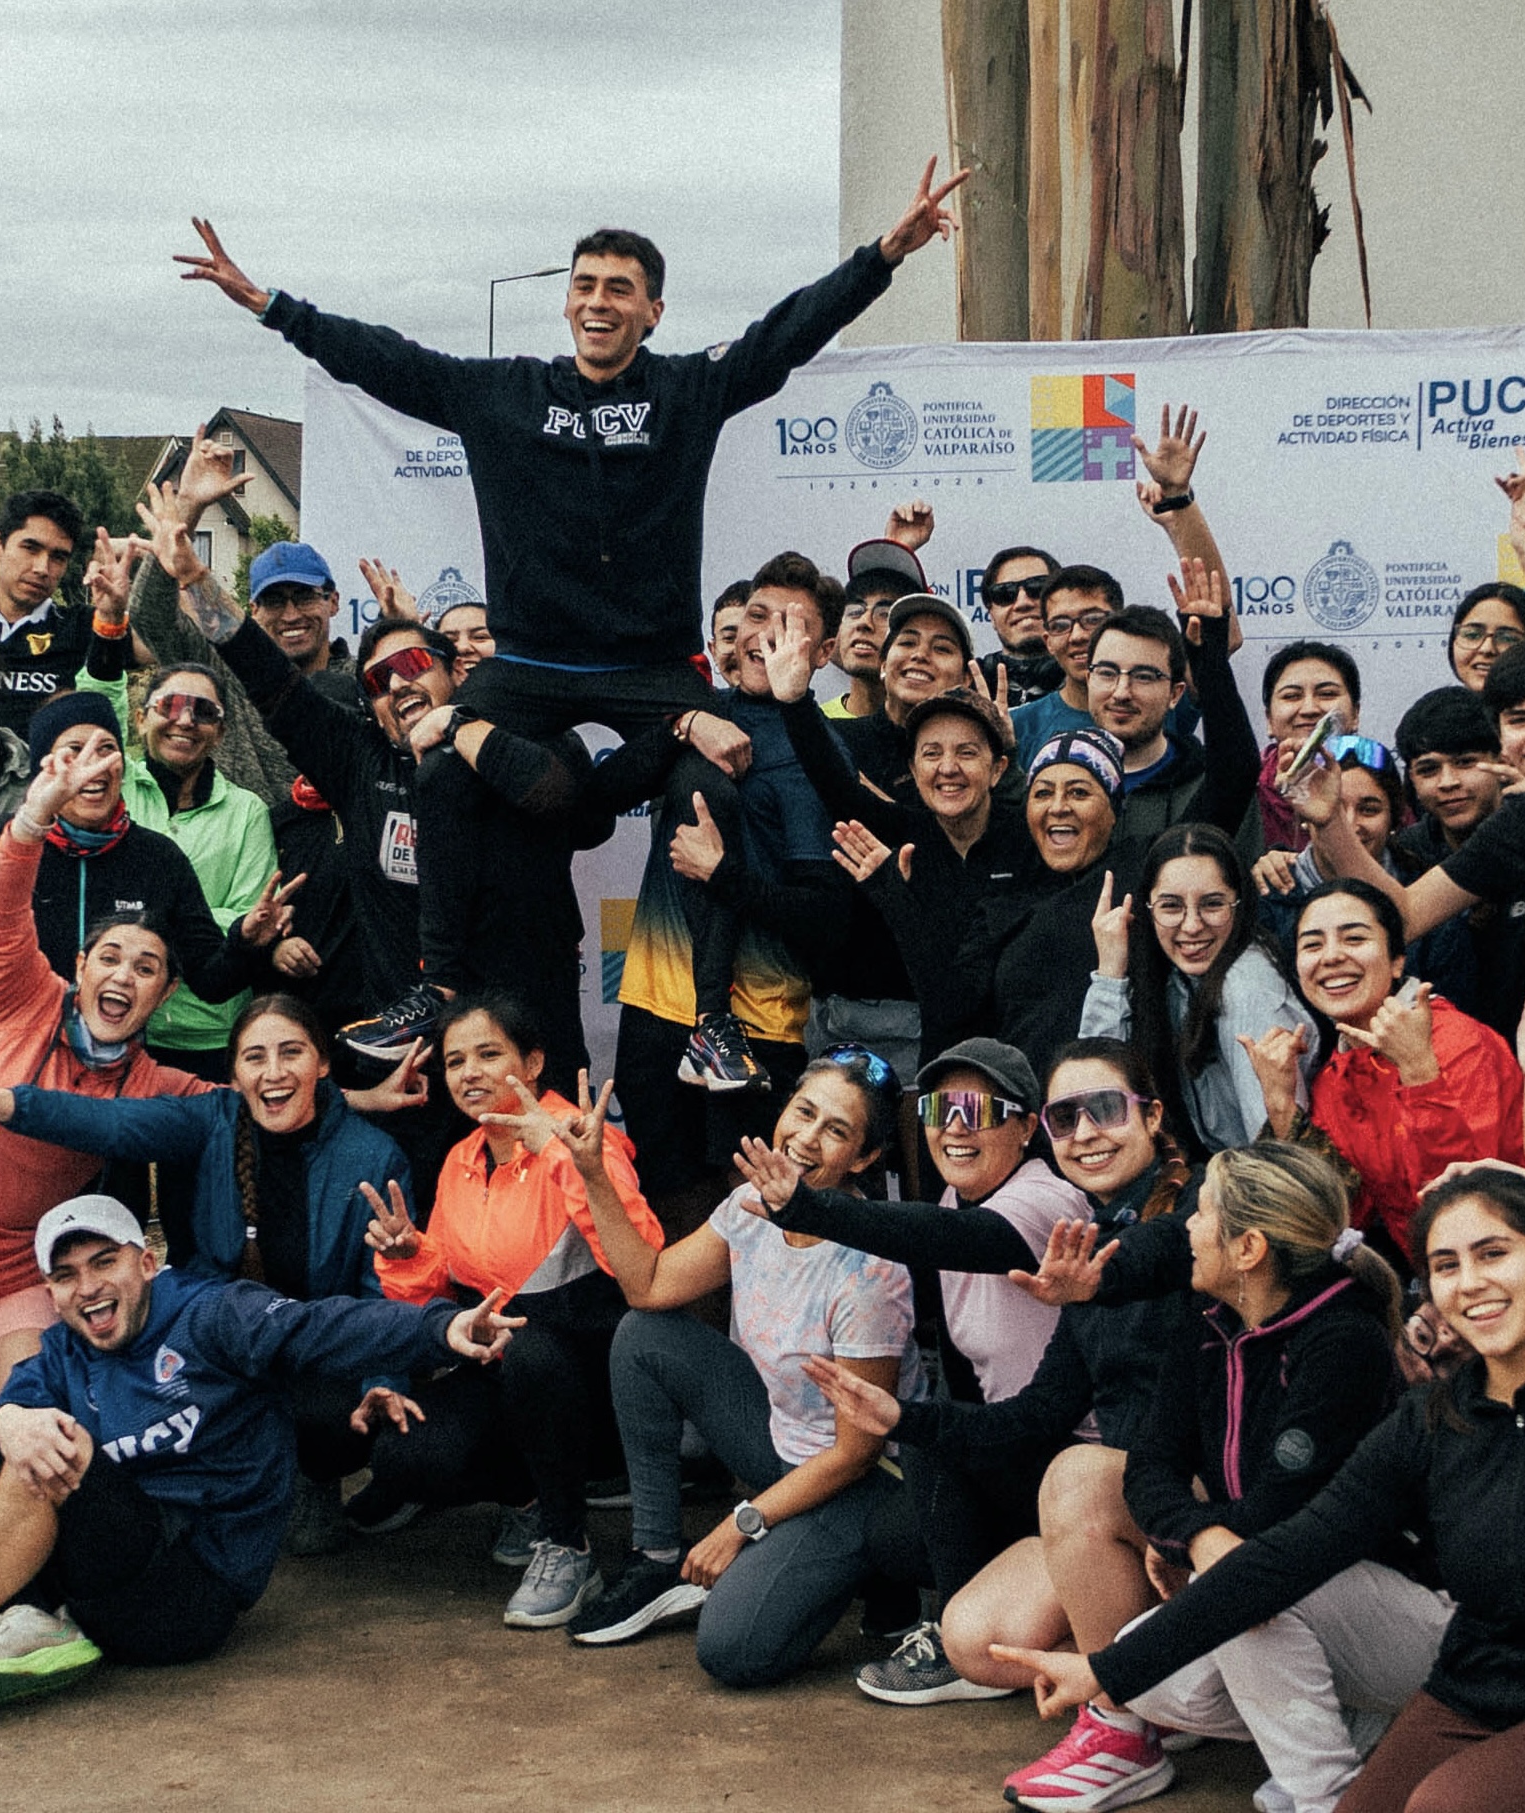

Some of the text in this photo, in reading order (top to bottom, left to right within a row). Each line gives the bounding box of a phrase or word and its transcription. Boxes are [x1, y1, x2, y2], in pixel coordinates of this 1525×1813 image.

[923, 401, 983, 412] PONTIFICIA
[1326, 395, 1411, 410] DIRECCIÓN
[923, 414, 996, 425] UNIVERSIDAD
[1293, 413, 1411, 427] DE DEPORTES Y
[1432, 415, 1495, 435] Activa
[775, 417, 838, 455] 100
[923, 425, 1013, 440] CATÓLICA DE
[1277, 428, 1411, 445] ACTIVIDAD FÍSICA
[790, 441, 837, 455] AÑOS
[924, 439, 1015, 456] VALPARAÍSO
[406, 450, 464, 463] DE DEPO
[394, 465, 463, 478] ACTIVIDAD
[1385, 562, 1448, 573] PONTIFICIA
[1385, 575, 1461, 586] UNIVERSIDAD
[1232, 576, 1295, 616] 100
[1385, 586, 1461, 602] CATÓLICA
[1246, 602, 1295, 616] AÑOS
[1385, 604, 1456, 618] VALPARA
[348, 598, 380, 635] 10
[393, 847, 411, 861] DE
